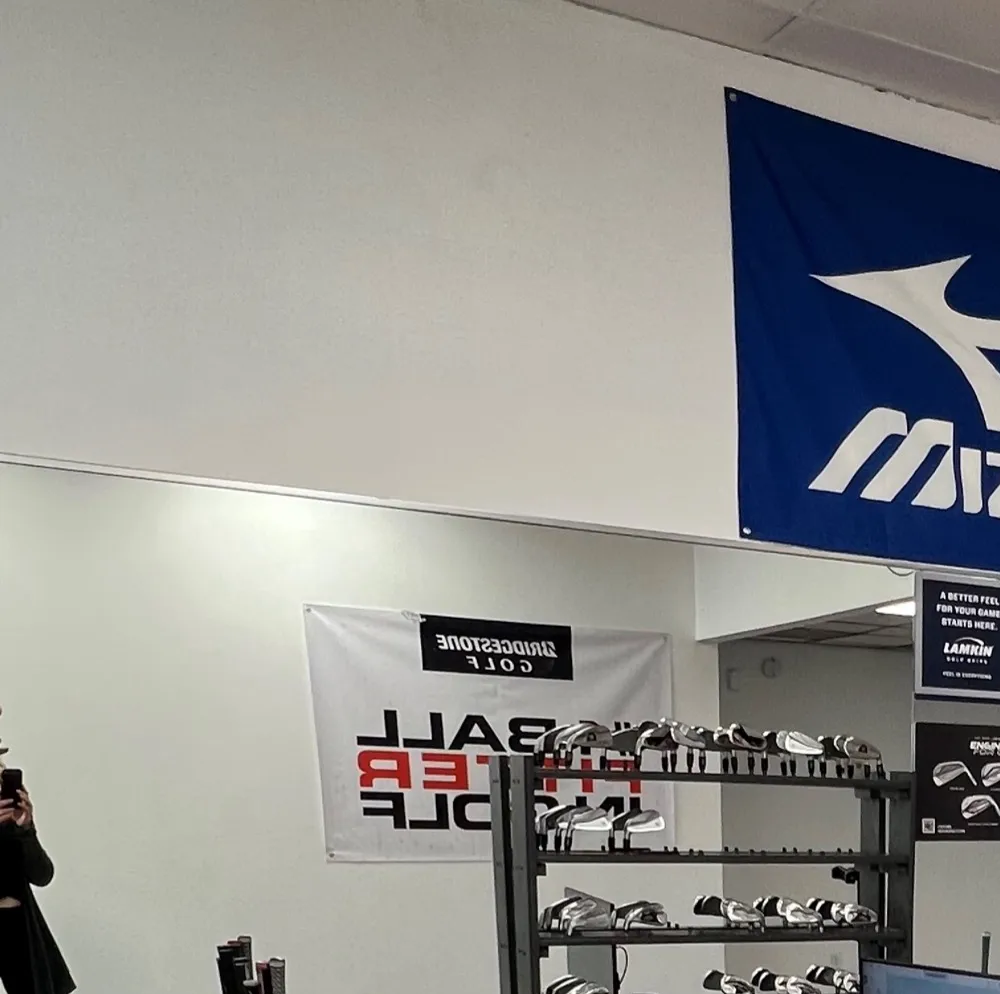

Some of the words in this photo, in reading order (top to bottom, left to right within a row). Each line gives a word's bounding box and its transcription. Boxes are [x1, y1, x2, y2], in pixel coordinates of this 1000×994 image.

[939, 591, 946, 600] A
[947, 592, 980, 603] BETTER
[980, 595, 1000, 606] FEEL
[936, 603, 953, 613] FOR
[954, 605, 977, 616] YOUR
[941, 617, 973, 628] STARTS
[943, 642, 994, 657] LAMKIN
